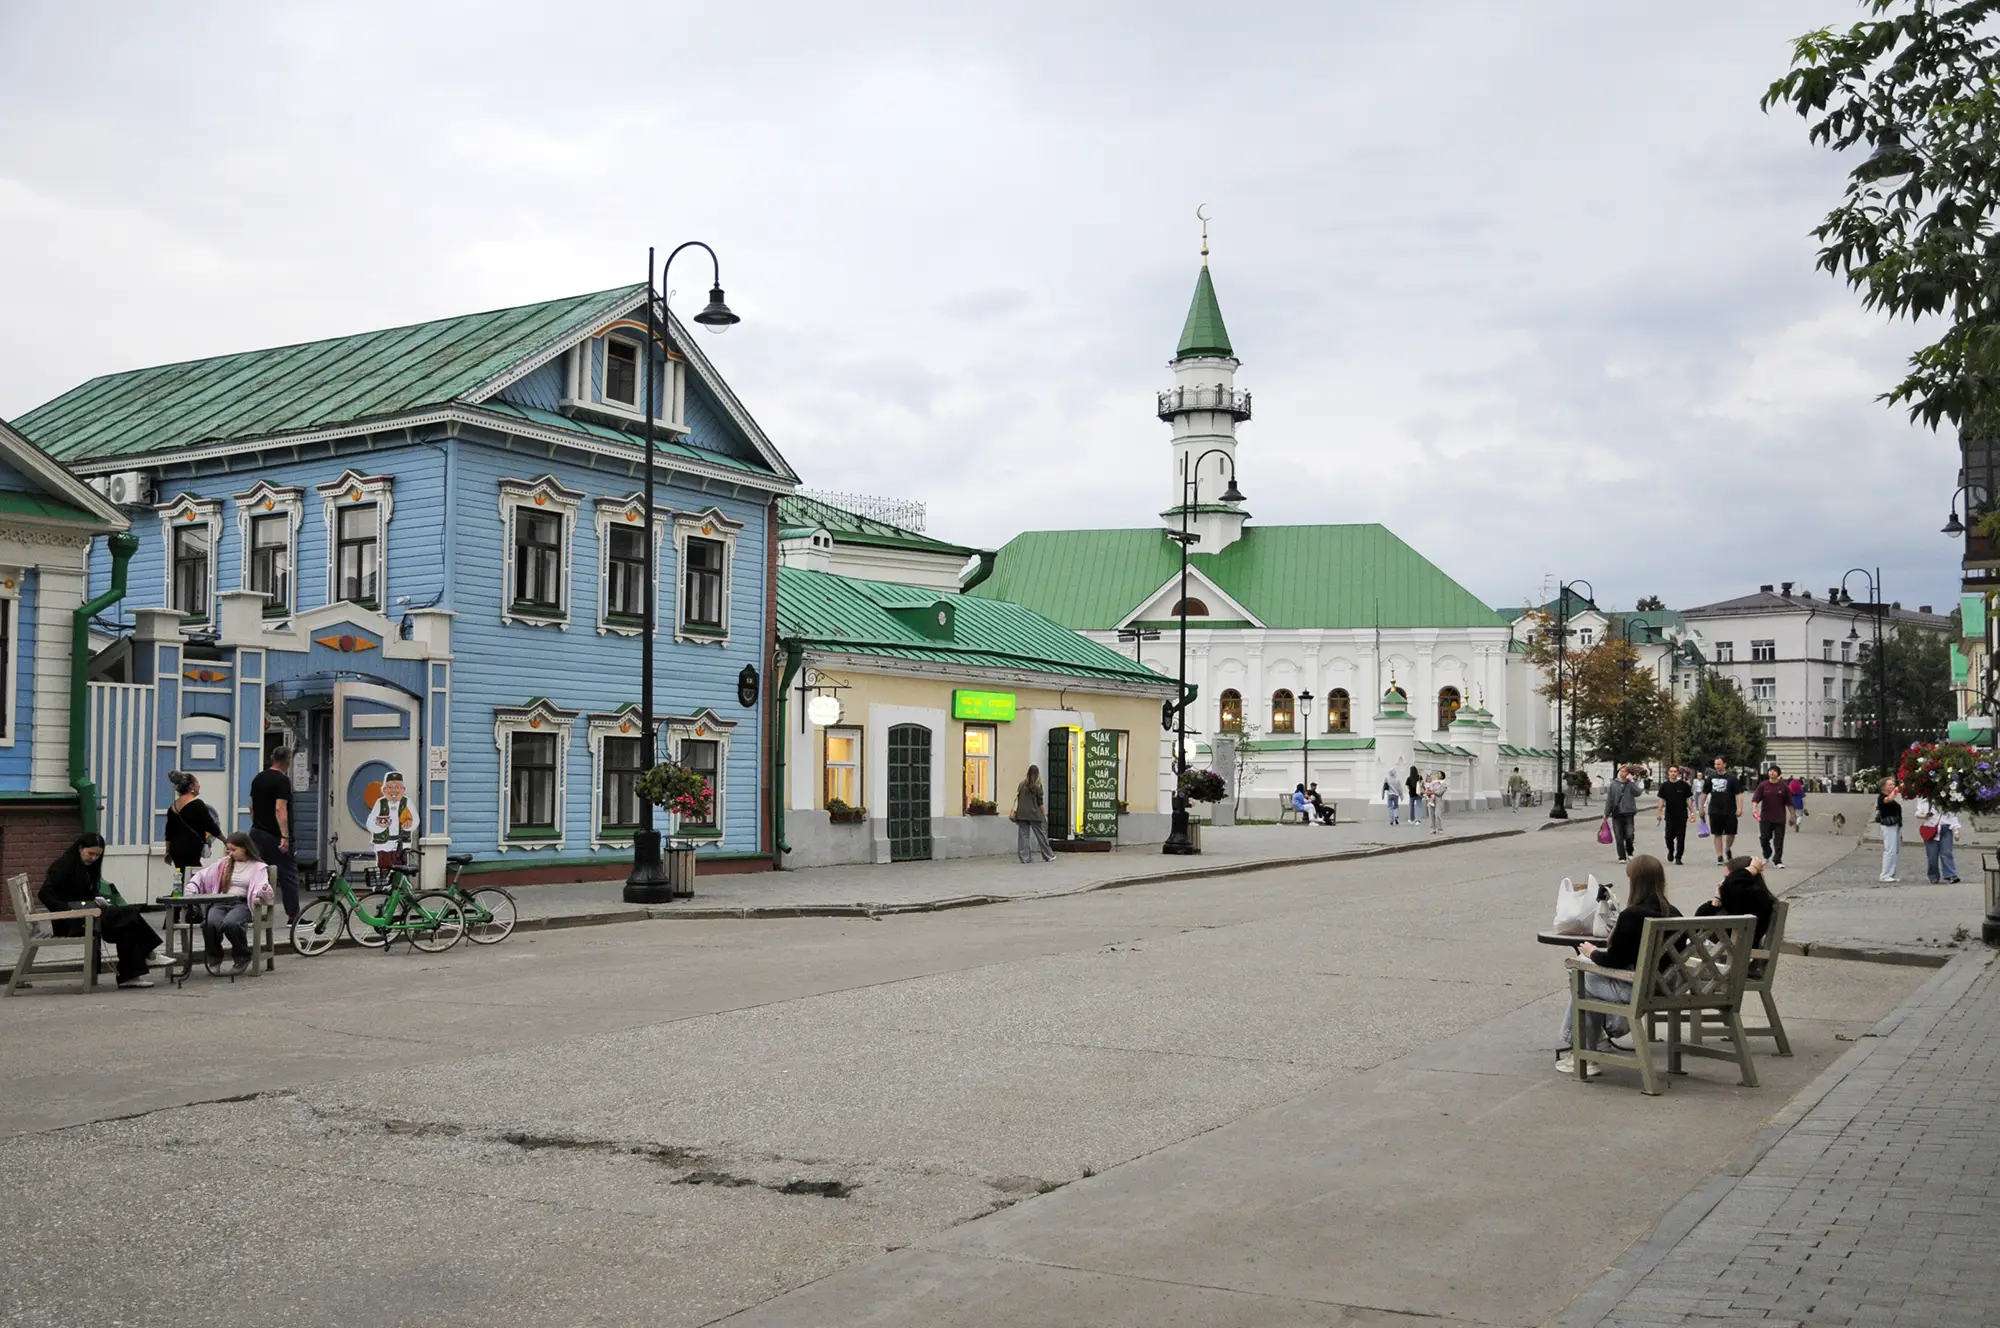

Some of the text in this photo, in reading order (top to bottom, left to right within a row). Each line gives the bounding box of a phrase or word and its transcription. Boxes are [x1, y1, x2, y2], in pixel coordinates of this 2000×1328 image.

[1091, 732, 1110, 742] ЧАК
[1088, 760, 1116, 768] ТАТАРСКИЙ
[1095, 768, 1109, 778] ЧАЙ
[1088, 792, 1115, 800] ТАЛКЫШ
[1087, 812, 1116, 820] СУВЕНИРЫ
